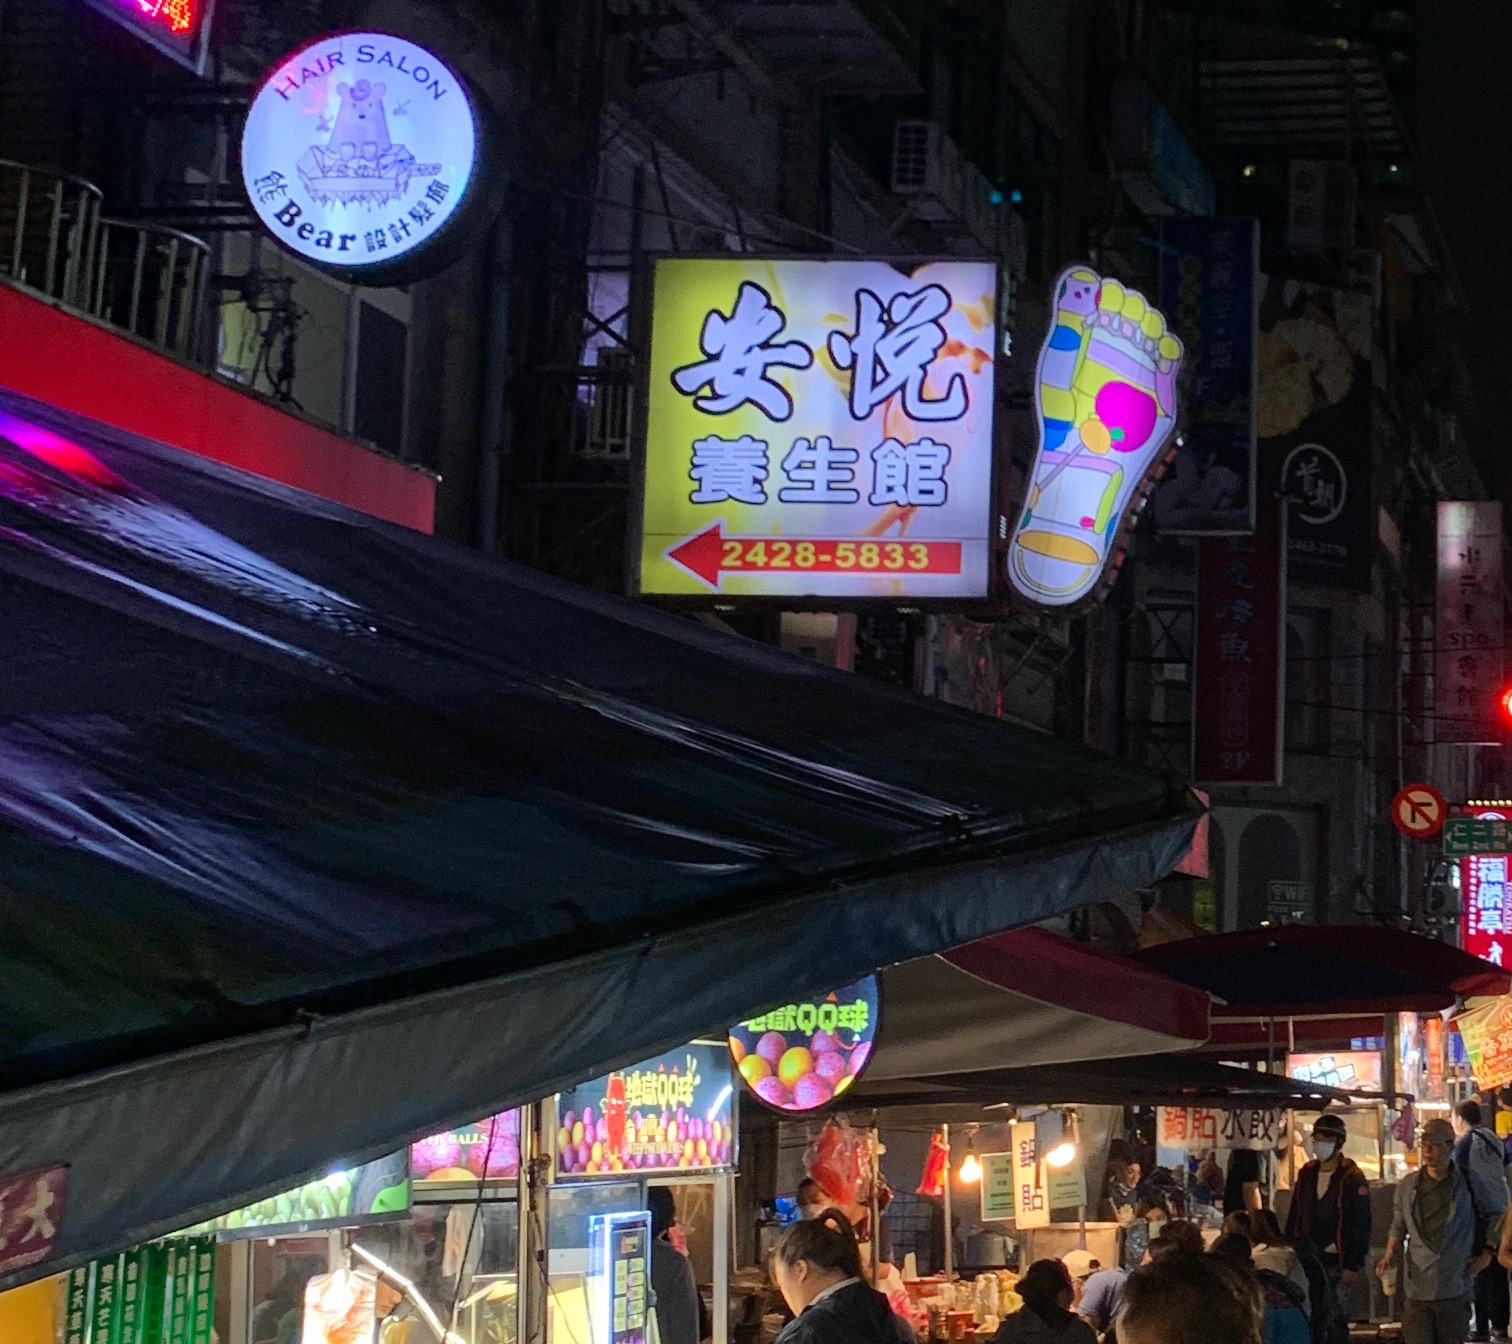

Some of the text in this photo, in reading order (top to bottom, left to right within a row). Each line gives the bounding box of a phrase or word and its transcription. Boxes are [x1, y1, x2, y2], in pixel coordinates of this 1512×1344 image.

[275, 44, 447, 101] HAIR SALON
[253, 169, 289, 203] 熊
[273, 196, 357, 253] Bear
[688, 434, 952, 508] 養生館
[721, 541, 929, 570] 2428-5833
[449, 1133, 489, 1146] BALLS
[1164, 1106, 1275, 1142] 鍋貼水餃
